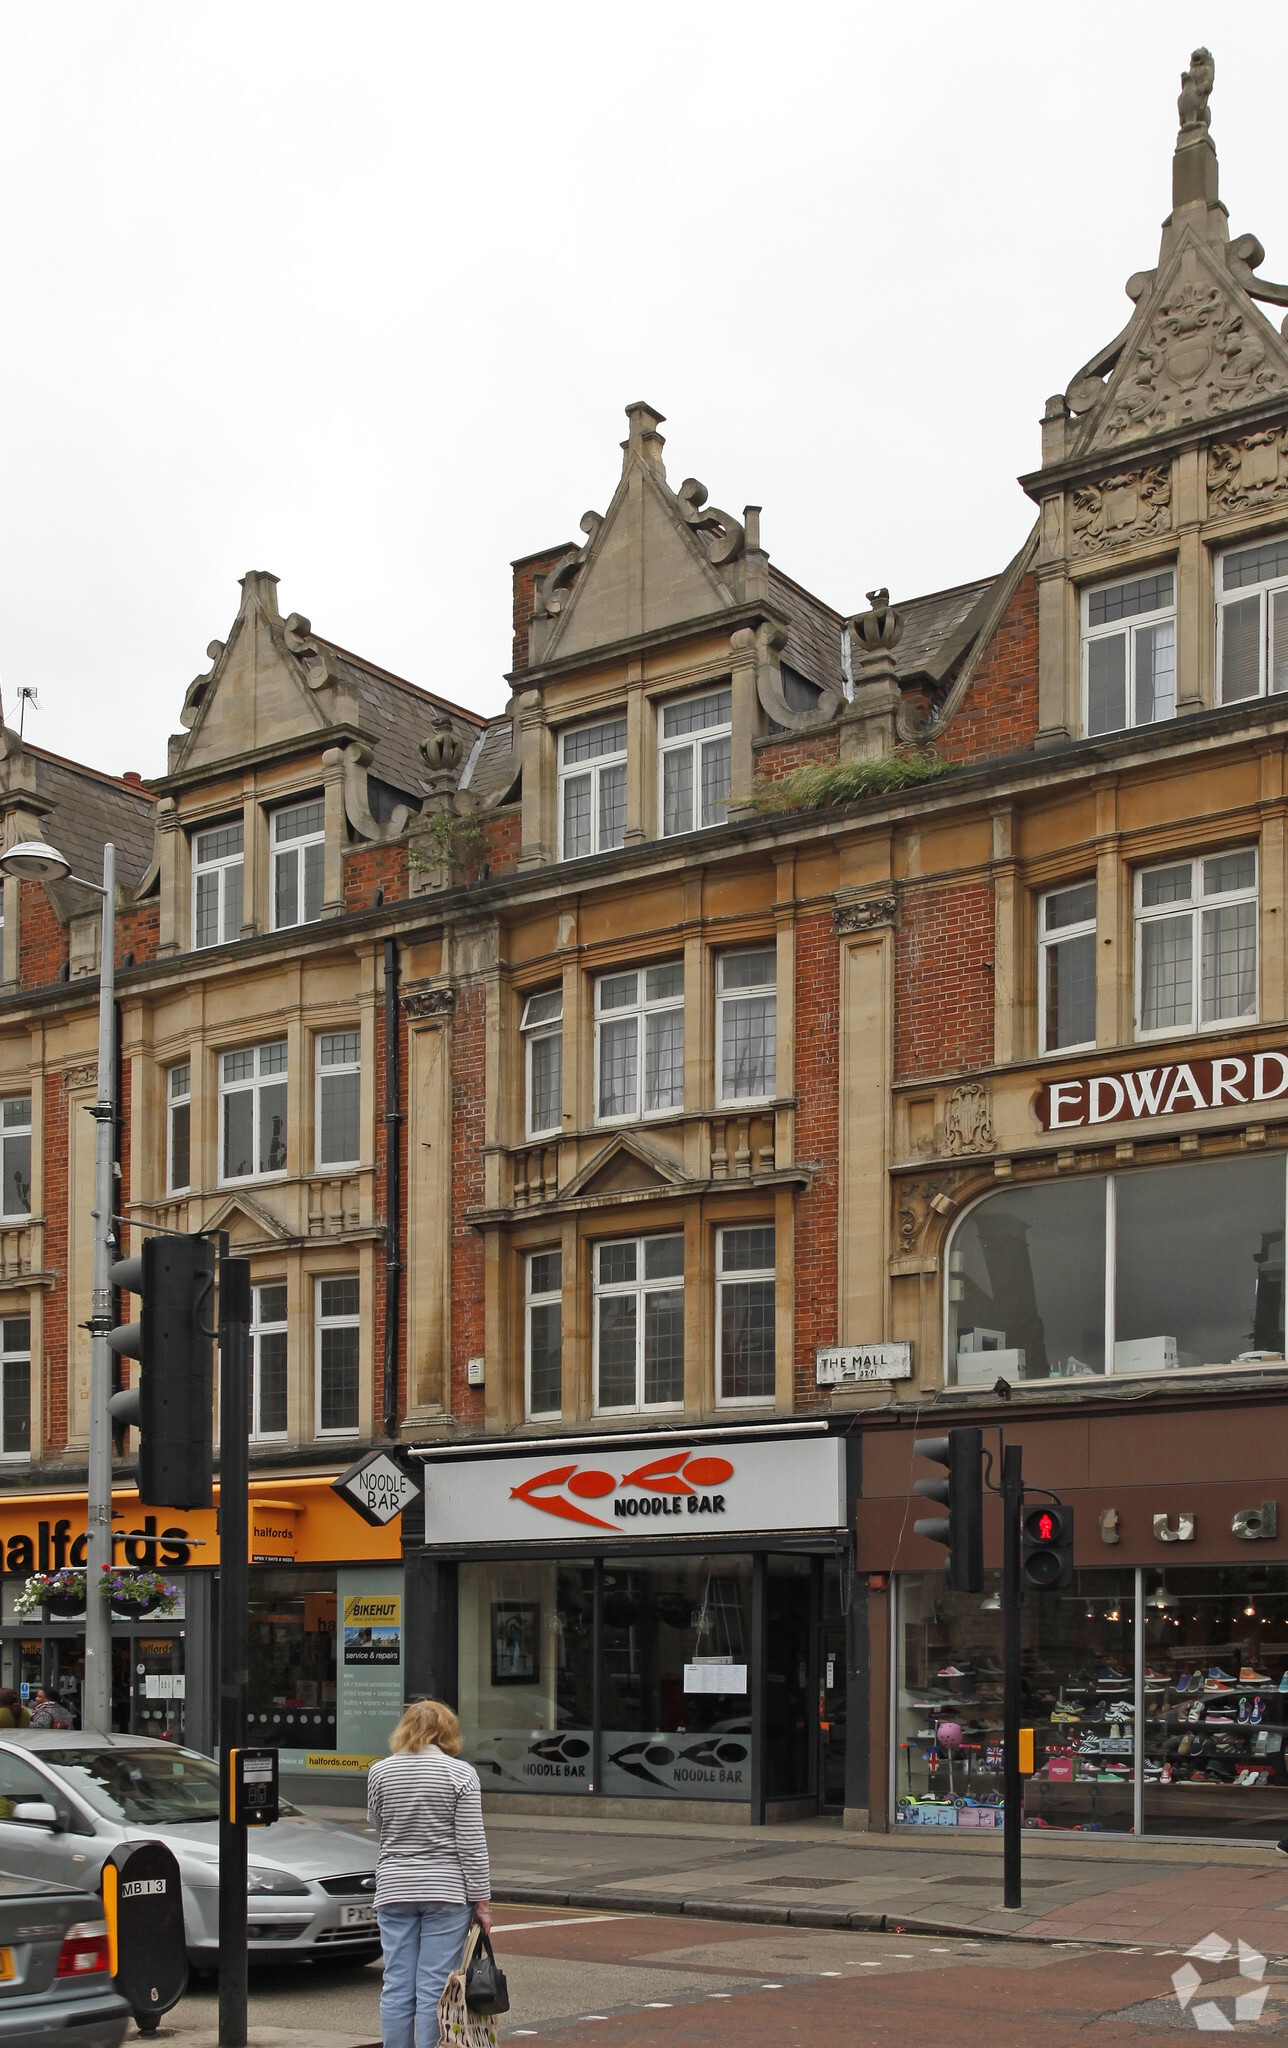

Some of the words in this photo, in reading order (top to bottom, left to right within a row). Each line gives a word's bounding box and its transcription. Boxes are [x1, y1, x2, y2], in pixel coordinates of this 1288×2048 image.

[821, 1357, 846, 1369] THE
[852, 1354, 887, 1367] MALL
[359, 1472, 407, 1493] NOODLE
[367, 1490, 401, 1511] BAR
[614, 1497, 681, 1516] NOODLE
[687, 1494, 726, 1514] BAR
[253, 1526, 294, 1539] halfords
[353, 1604, 396, 1616] BIKEHUT
[369, 1651, 375, 1659] &
[375, 1652, 398, 1660] repairs
[308, 1757, 359, 1767] halfords.com
[564, 1764, 586, 1778] BAR
[673, 1768, 717, 1783] NOODLE
[718, 1769, 743, 1784] BAR
